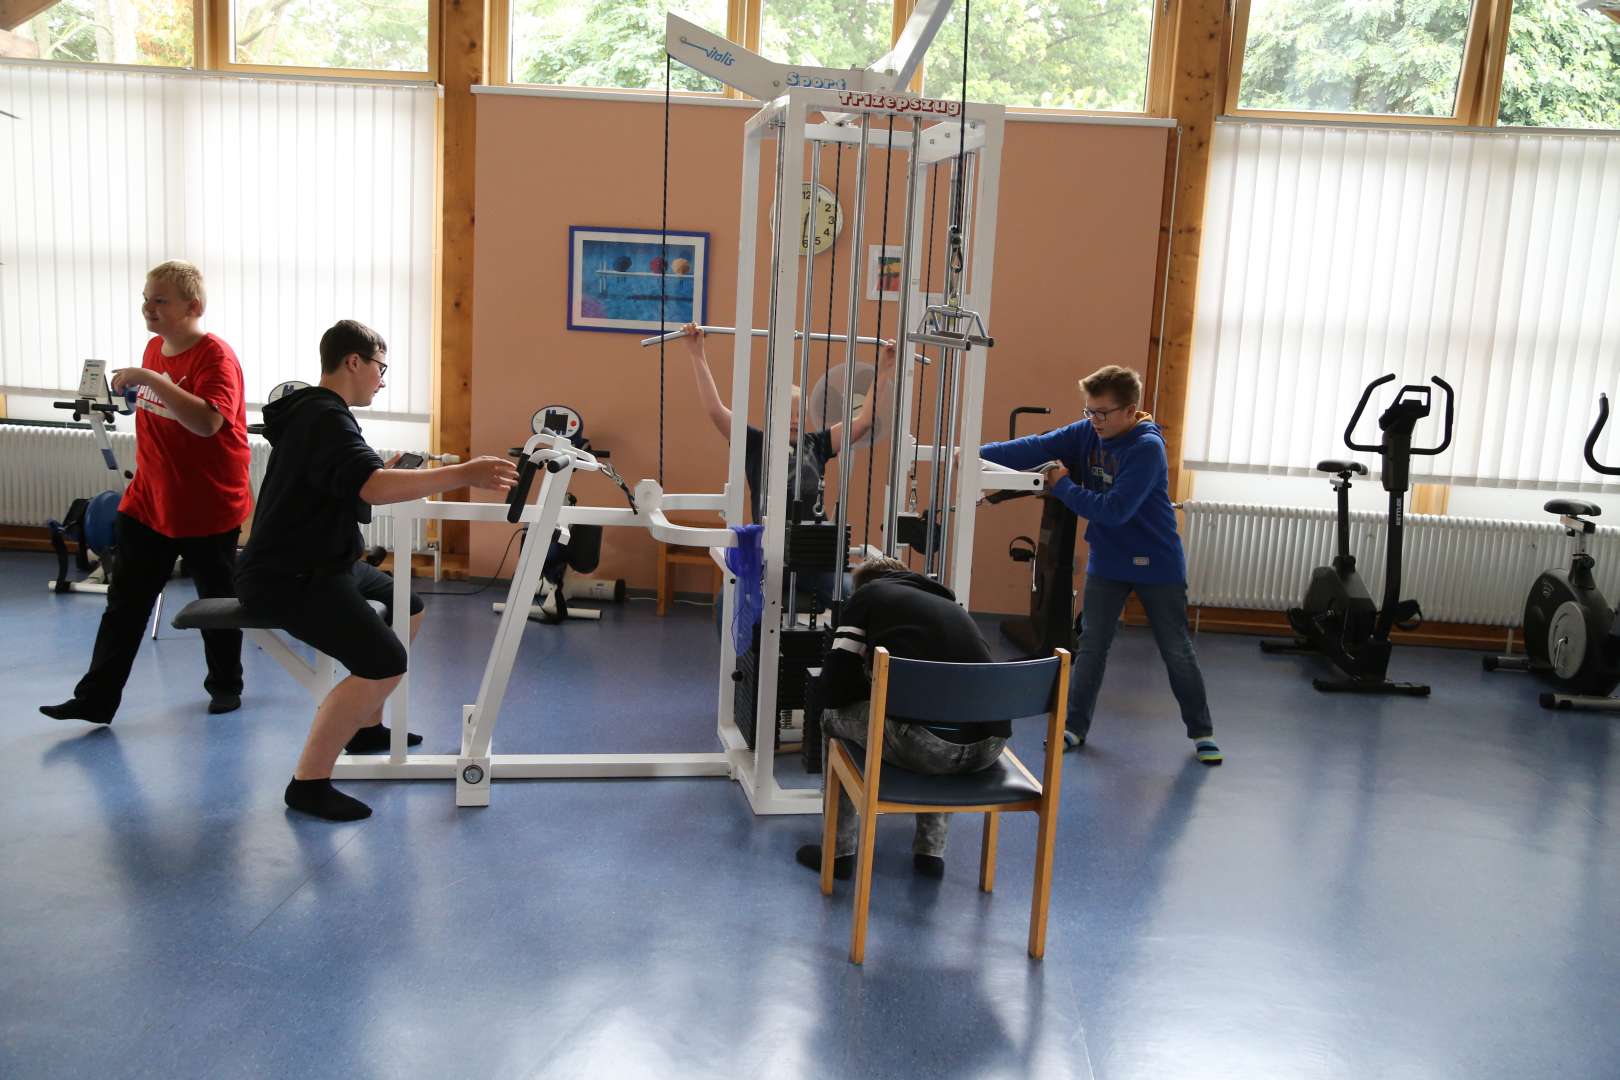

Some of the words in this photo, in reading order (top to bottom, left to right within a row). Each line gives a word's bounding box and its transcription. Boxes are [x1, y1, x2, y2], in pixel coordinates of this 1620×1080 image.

[785, 71, 847, 90] Sport
[838, 91, 961, 117] Trizepszug
[802, 191, 811, 200] 12
[825, 203, 832, 212] 2
[828, 216, 836, 225] 3
[823, 228, 830, 237] 4
[815, 237, 821, 246] 5
